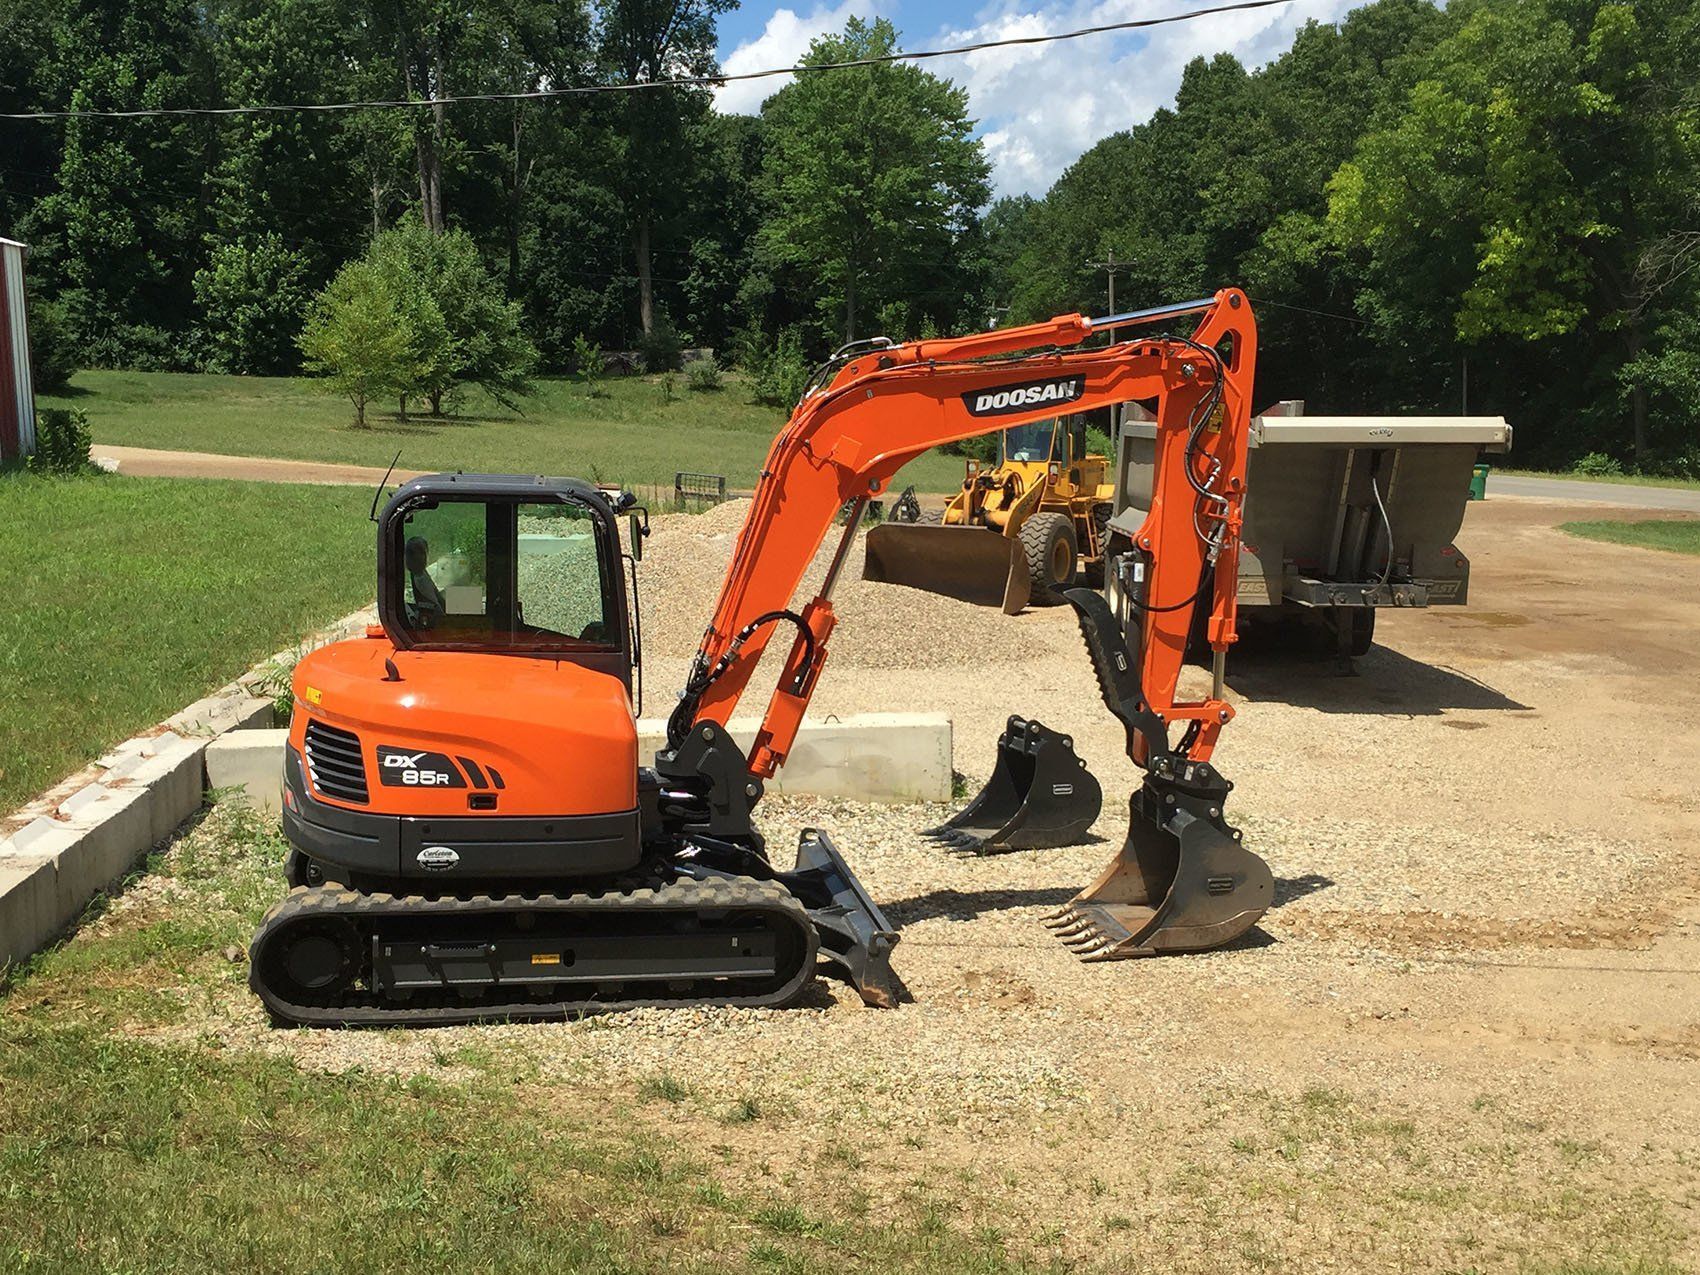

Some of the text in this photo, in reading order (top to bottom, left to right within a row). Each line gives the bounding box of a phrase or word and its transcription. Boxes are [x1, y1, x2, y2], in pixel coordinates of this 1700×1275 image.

[975, 380, 1076, 412] DOOSAN
[384, 752, 427, 768] DX
[402, 770, 449, 785] 85R
